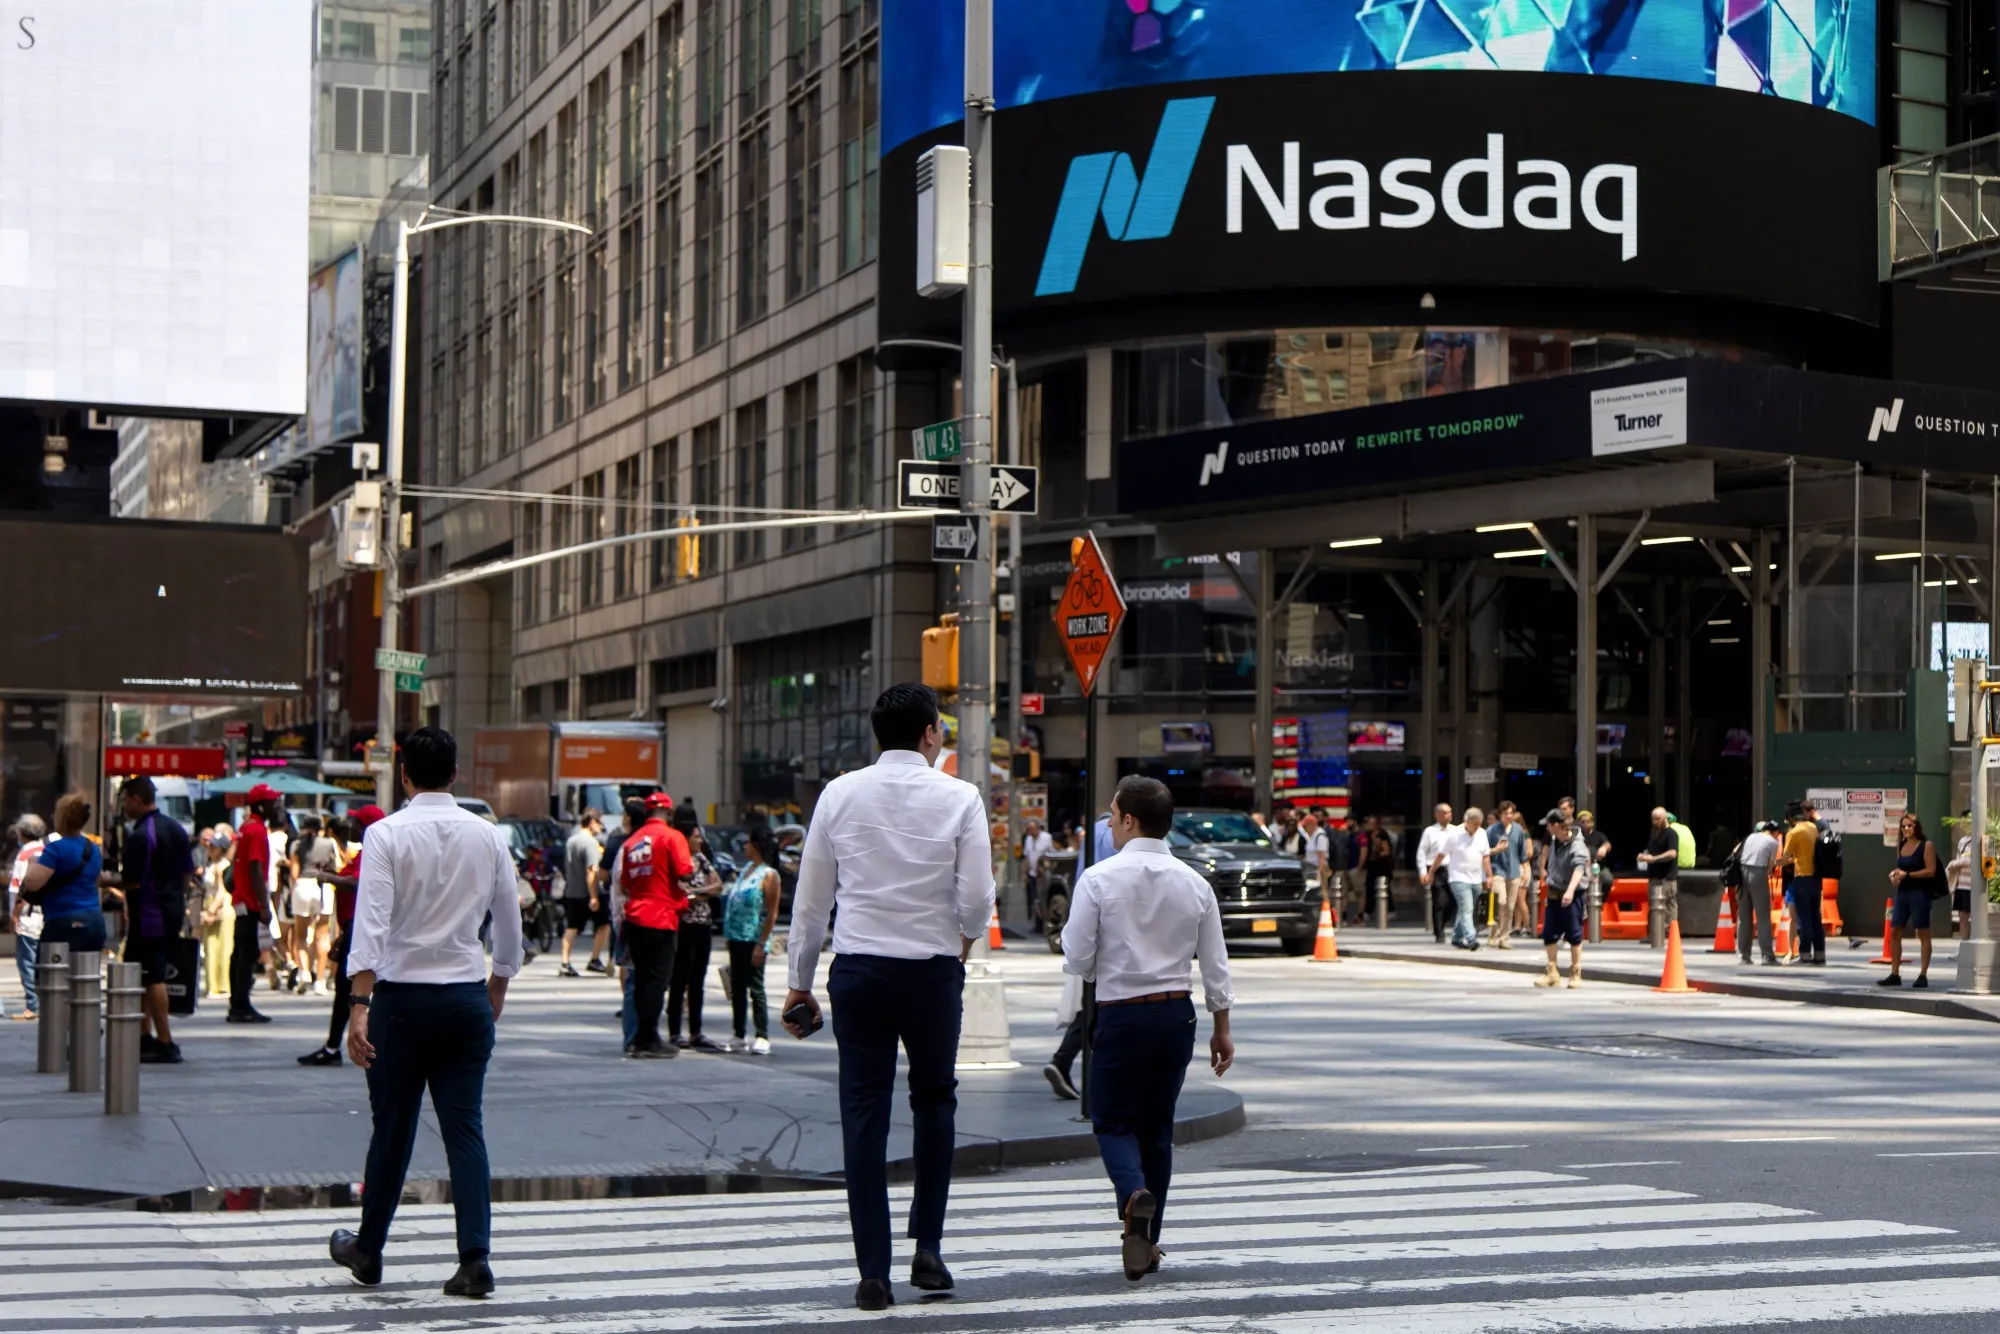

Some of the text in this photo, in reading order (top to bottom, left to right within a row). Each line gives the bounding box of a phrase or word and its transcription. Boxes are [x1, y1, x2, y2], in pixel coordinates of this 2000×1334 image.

[17, 16, 35, 50] S
[1226, 132, 1638, 262] Nasdaq
[1632, 392, 1645, 400] New
[1614, 413, 1663, 432] Turner
[1915, 414, 1985, 436] QUESTION
[925, 430, 937, 457] W
[941, 425, 956, 453] 43
[1236, 443, 1299, 466] QUESTION
[1304, 438, 1346, 458] TODAY
[1356, 426, 1423, 449] REWRITE
[920, 477, 1016, 498] ONE AY
[940, 528, 973, 547] ONE WAY
[1068, 615, 1108, 637] WORK ZONE
[1074, 641, 1101, 655] AHEAD
[377, 650, 424, 672] BROADWAY
[114, 753, 180, 769] DINER
